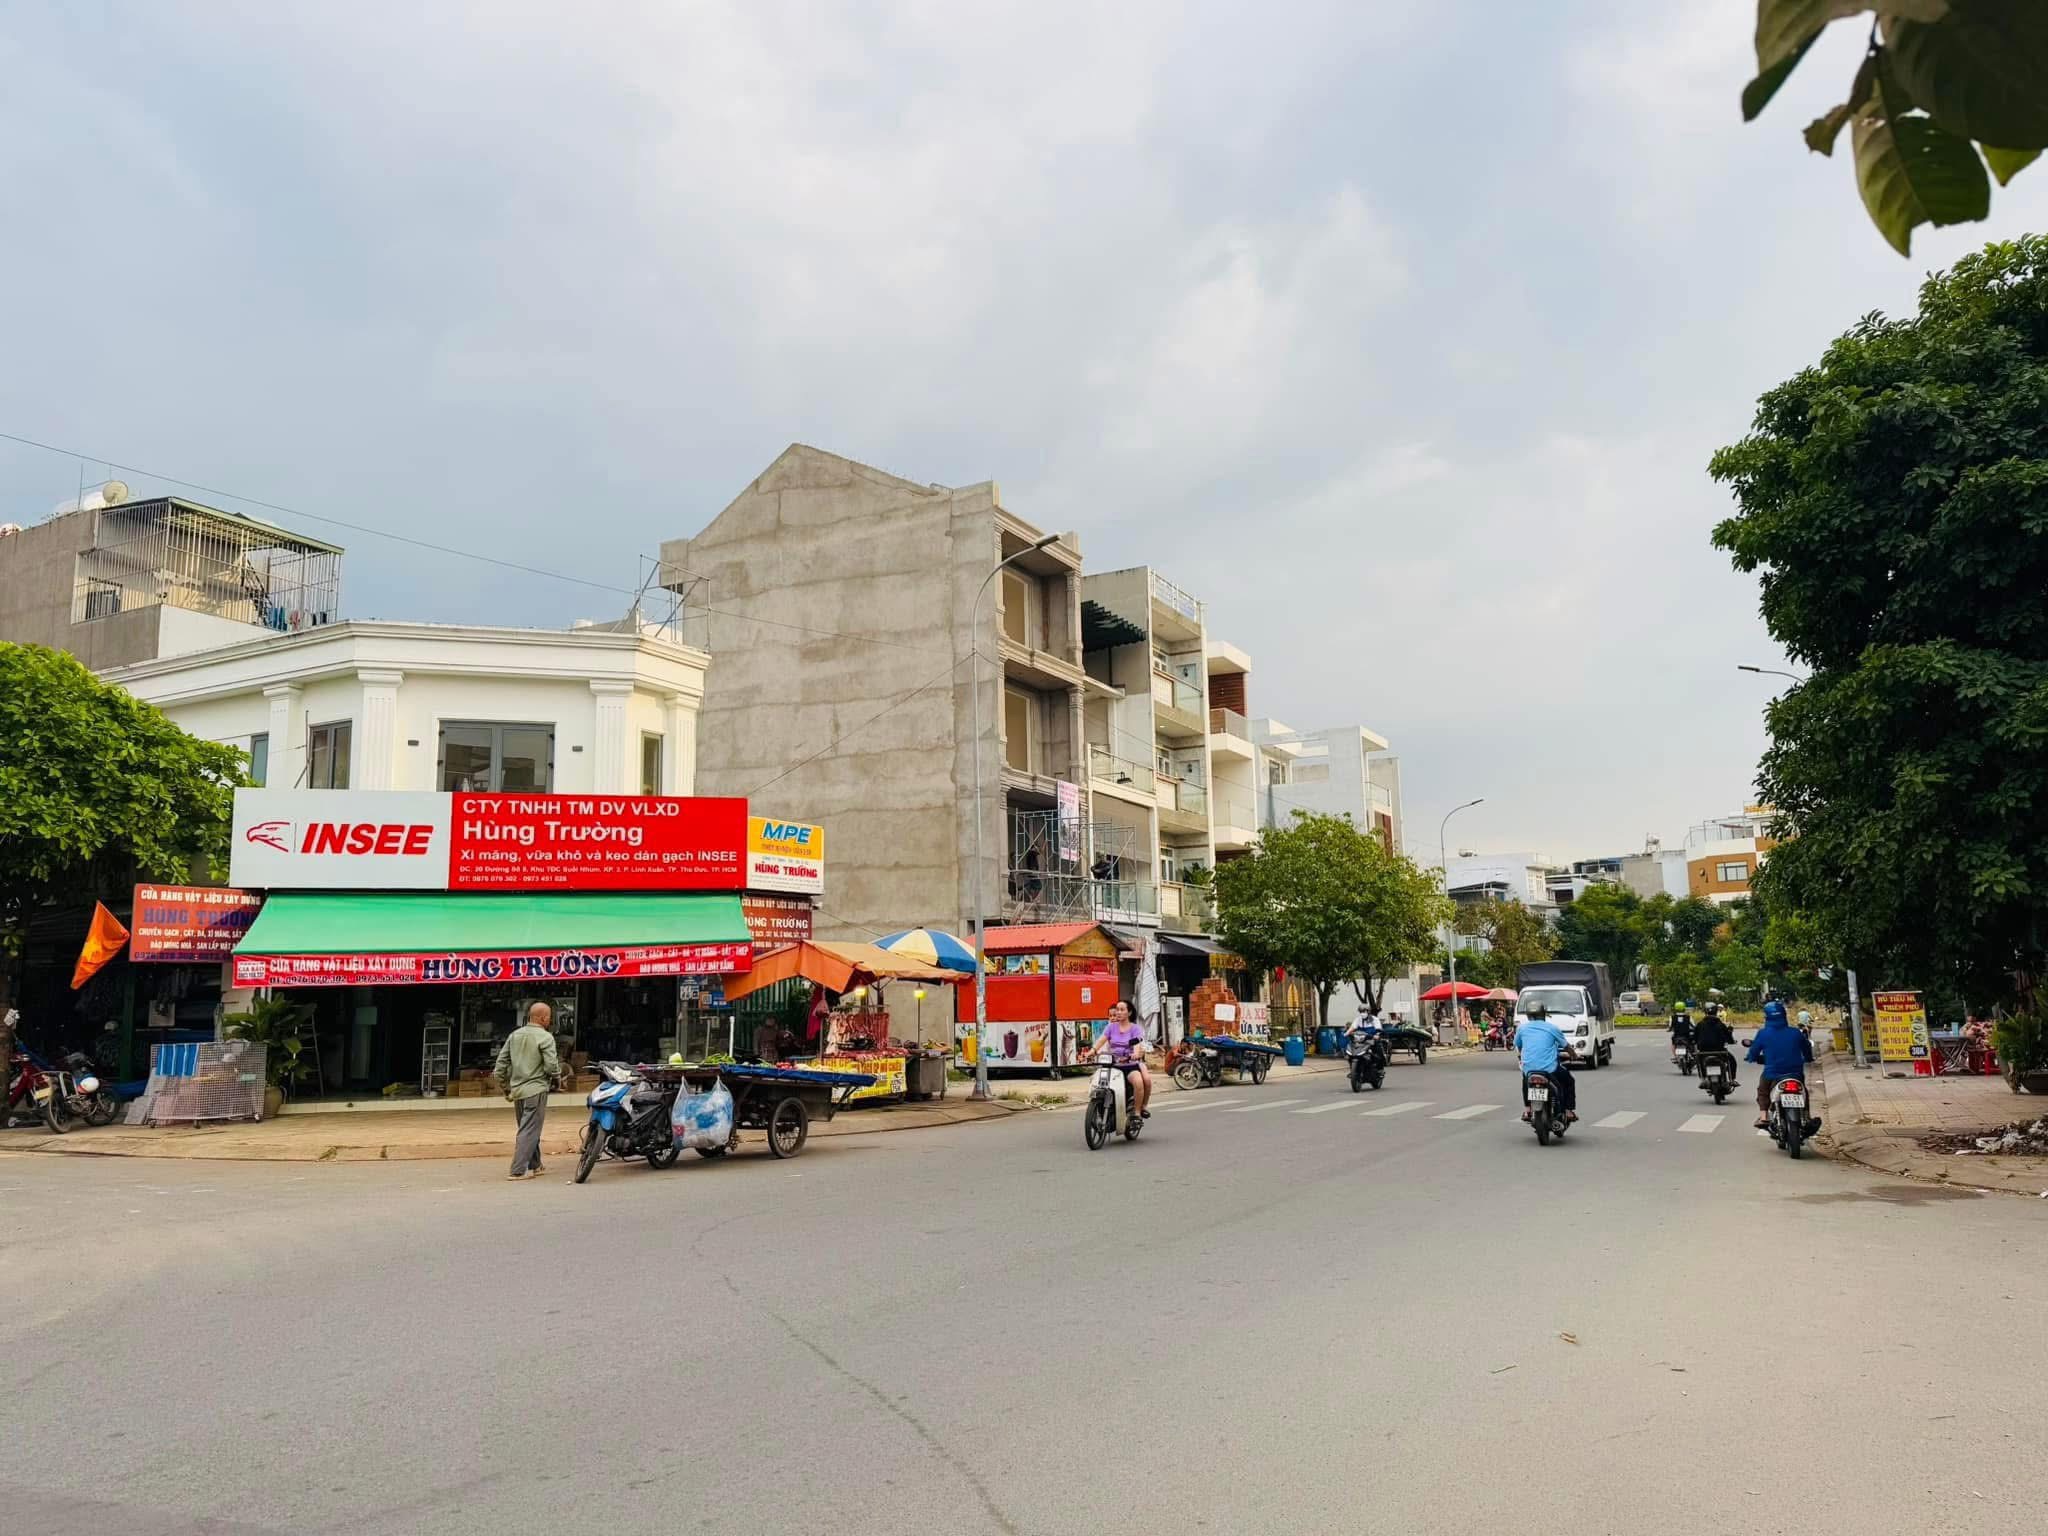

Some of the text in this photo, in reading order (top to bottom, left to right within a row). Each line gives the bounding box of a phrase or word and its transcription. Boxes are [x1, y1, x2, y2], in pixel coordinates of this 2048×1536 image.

[463, 799, 680, 817] CTY TNHH TM DV VLXD
[301, 823, 434, 855] INSEE
[463, 820, 644, 846] Hùng Trường
[763, 822, 812, 843] MPE
[586, 850, 601, 861] và
[605, 851, 631, 861] keo
[662, 851, 694, 864] gạch
[697, 851, 738, 862] INSEE
[755, 860, 780, 875] HÙNG
[421, 950, 620, 980] HÙNG TRƯỜNG
